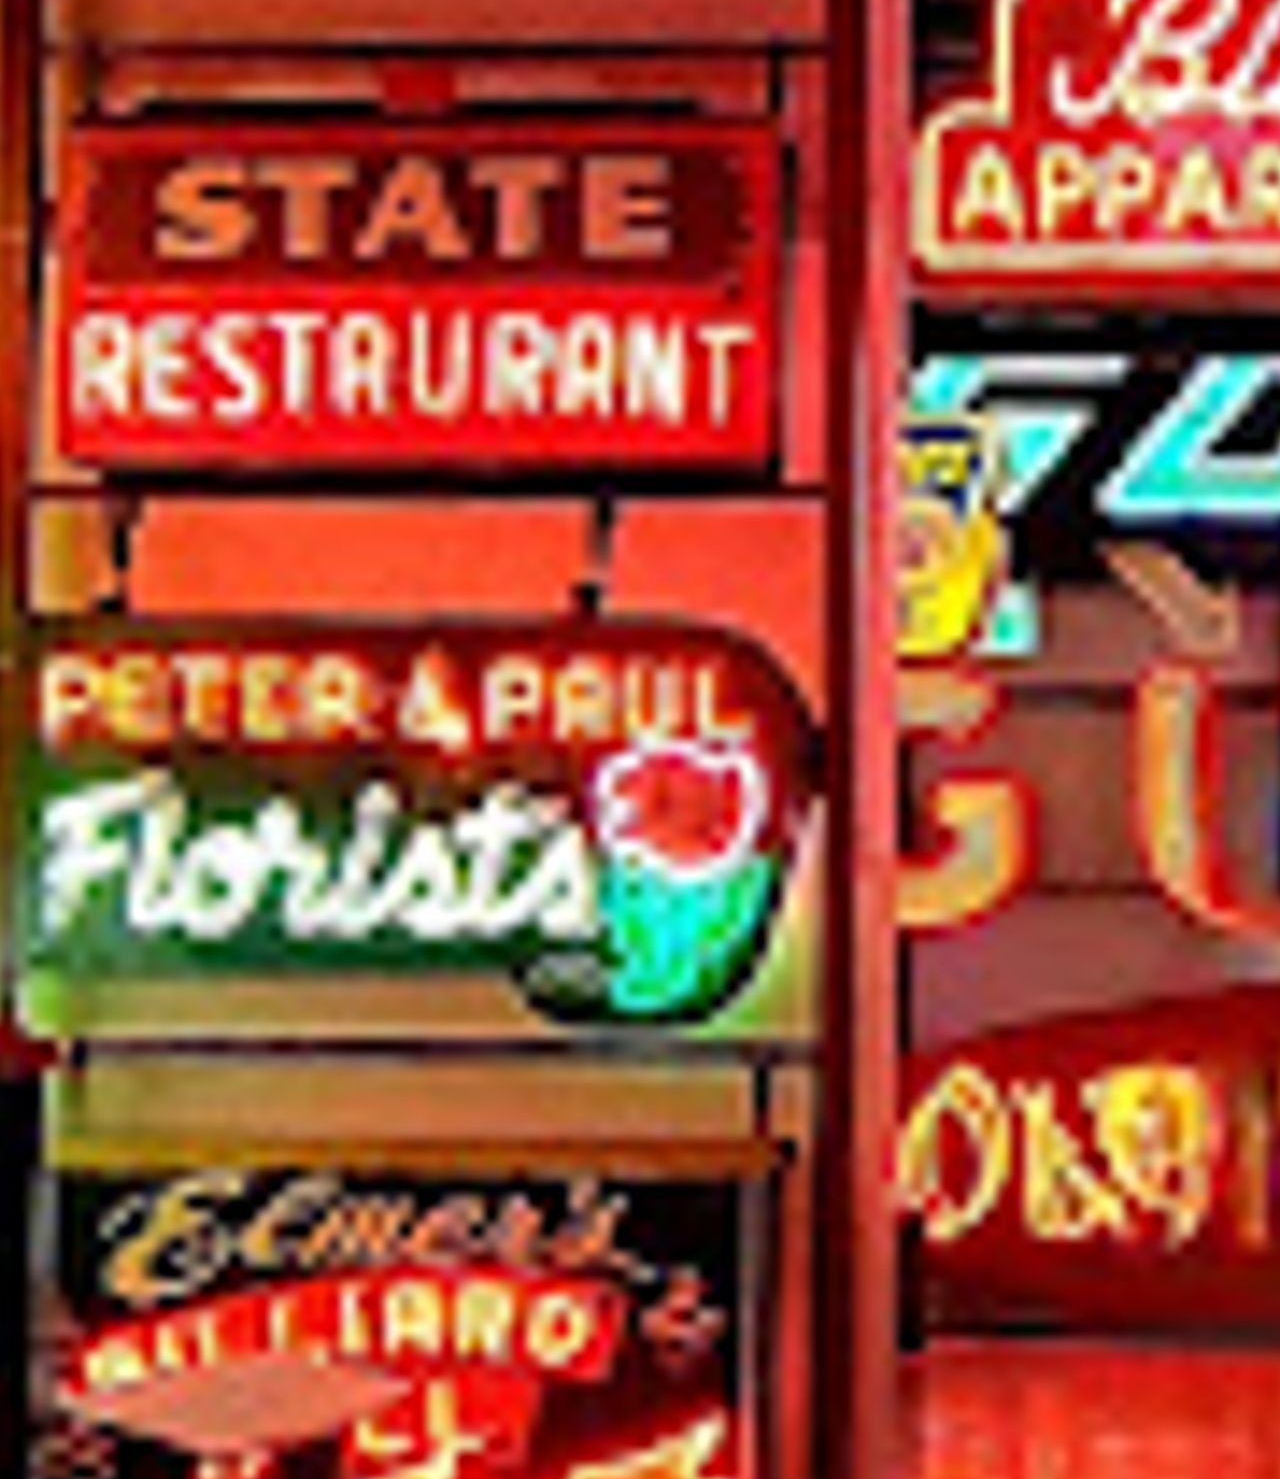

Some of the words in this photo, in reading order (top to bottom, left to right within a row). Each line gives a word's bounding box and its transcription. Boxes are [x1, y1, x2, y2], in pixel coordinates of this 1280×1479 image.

[152, 153, 674, 263] STATE
[70, 311, 758, 429] RESTAURANT
[42, 653, 382, 746] PETER
[482, 654, 756, 743] PAUL
[40, 771, 602, 941] Florists
